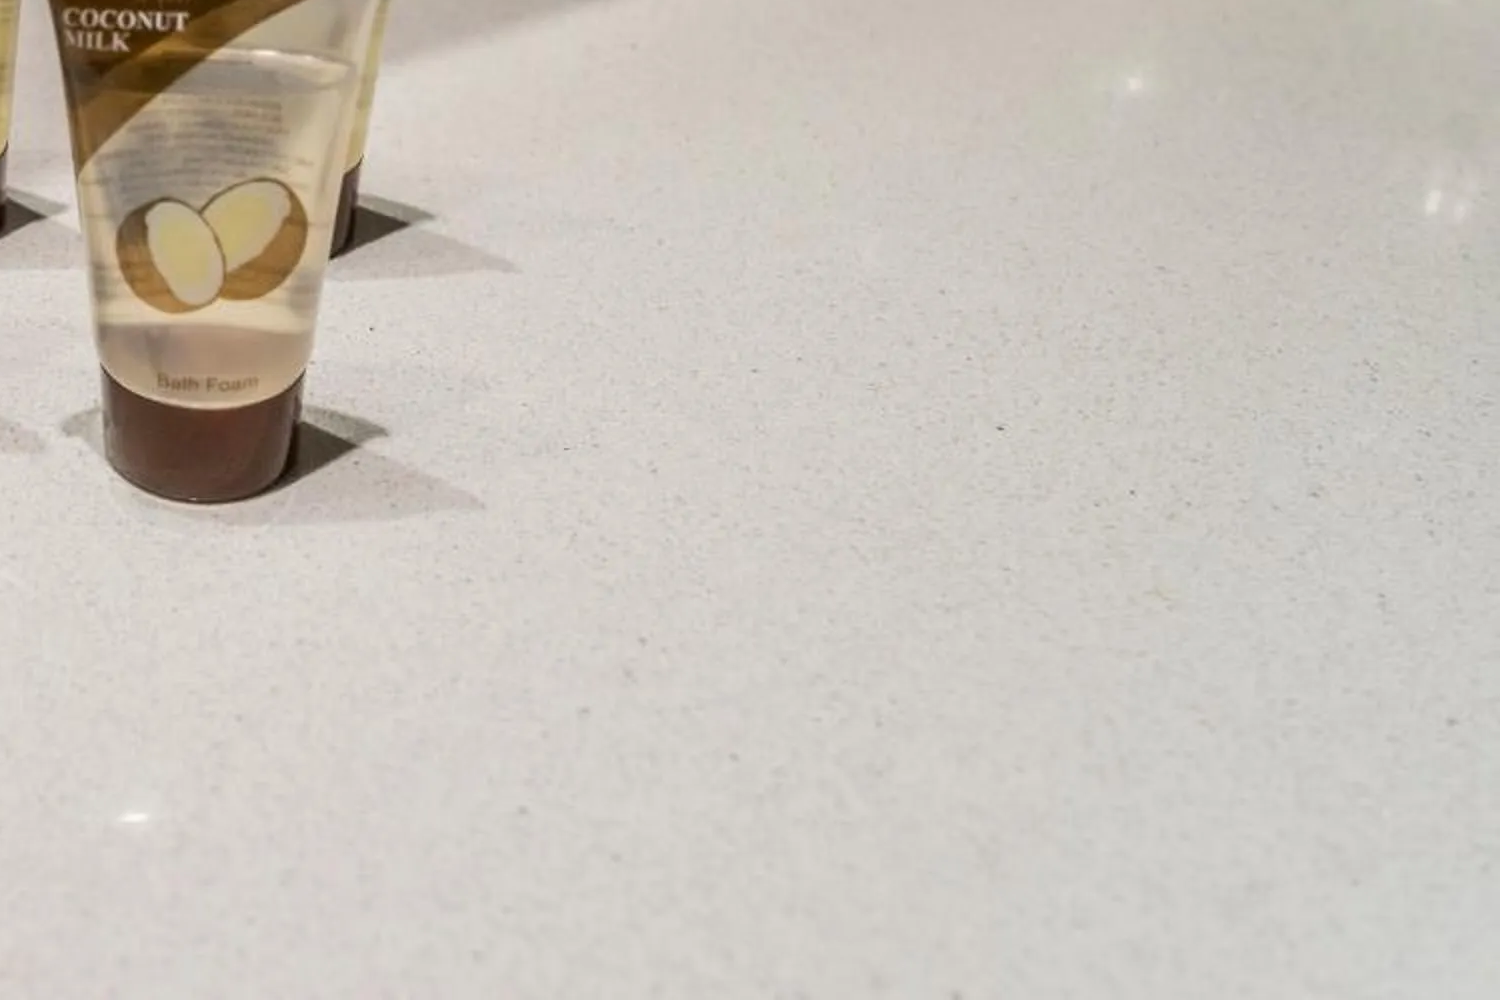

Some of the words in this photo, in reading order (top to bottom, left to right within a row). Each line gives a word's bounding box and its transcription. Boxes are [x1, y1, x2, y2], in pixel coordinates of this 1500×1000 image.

[63, 6, 190, 32] COCONUT
[64, 29, 131, 52] MILK
[205, 376, 260, 393] Foam
